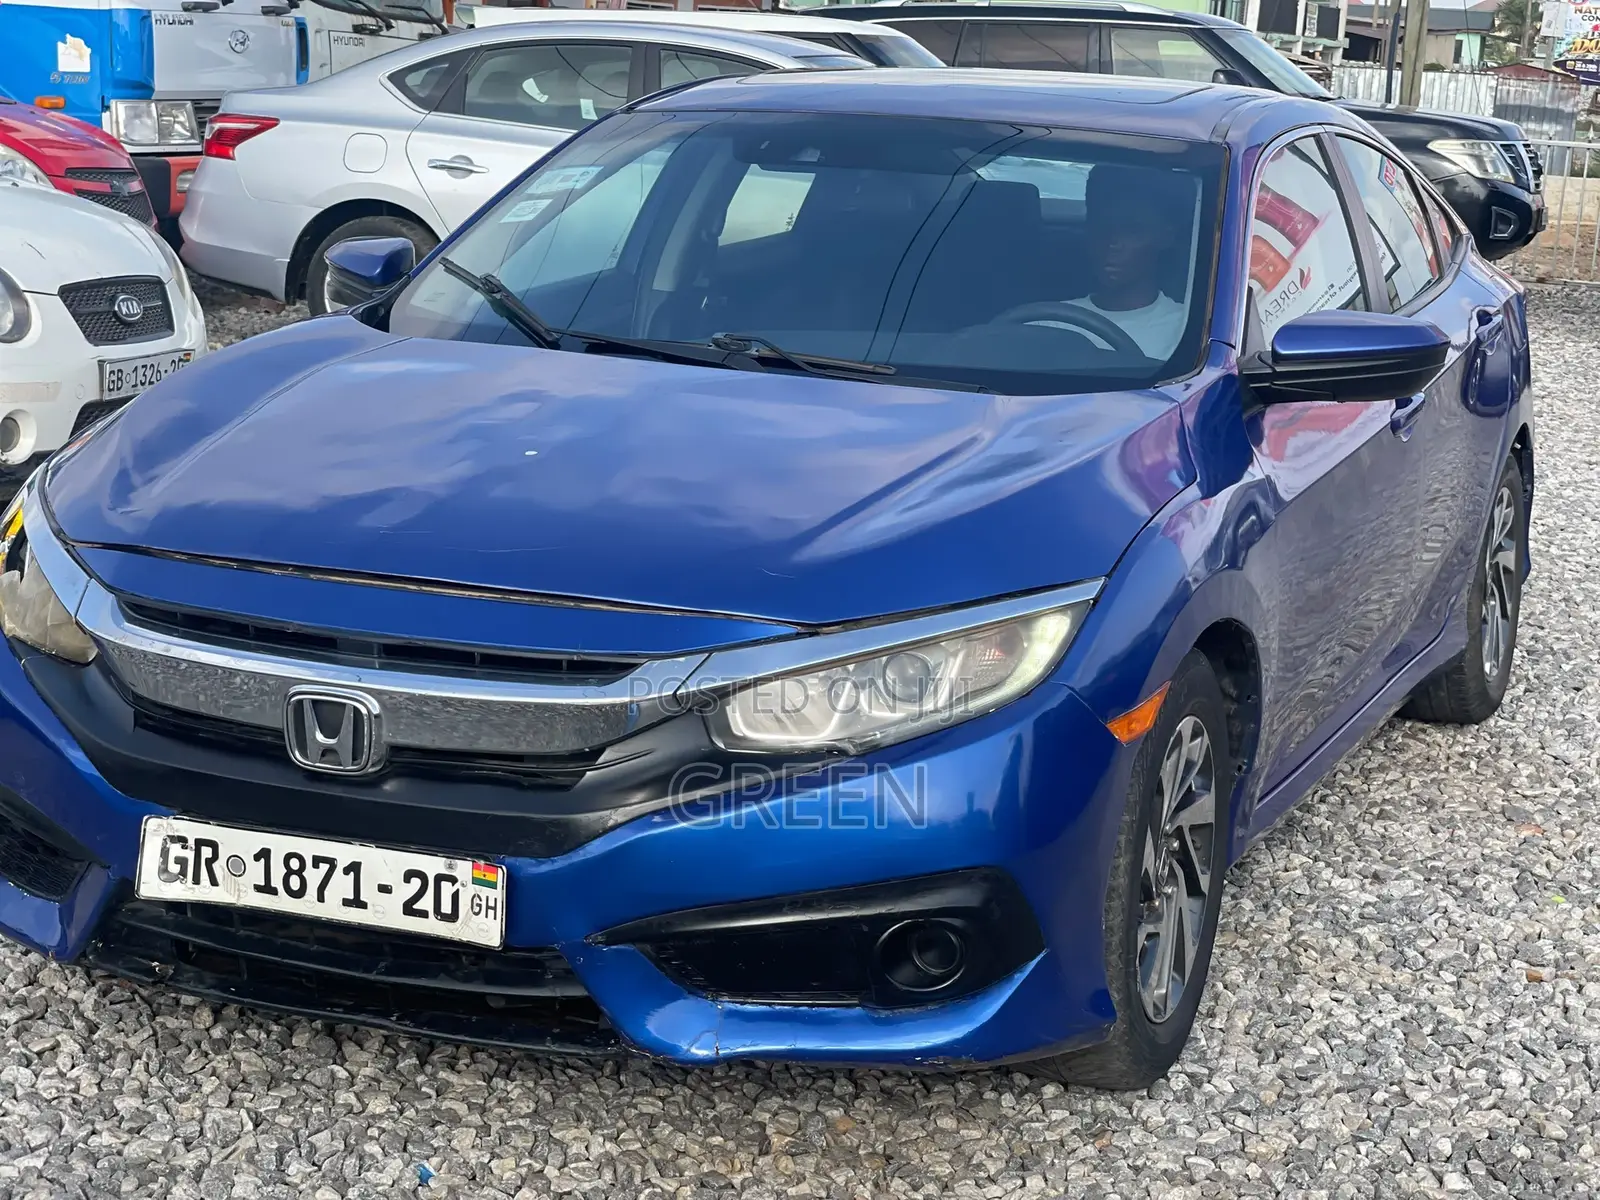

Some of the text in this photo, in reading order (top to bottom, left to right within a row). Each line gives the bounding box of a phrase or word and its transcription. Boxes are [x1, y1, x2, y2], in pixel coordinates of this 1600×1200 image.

[154, 13, 194, 26] HYUNDAI
[332, 35, 365, 48] HYUNDAI
[119, 300, 141, 316] KIA
[107, 367, 124, 393] GB
[157, 834, 220, 887] GR
[470, 893, 498, 921] GH
